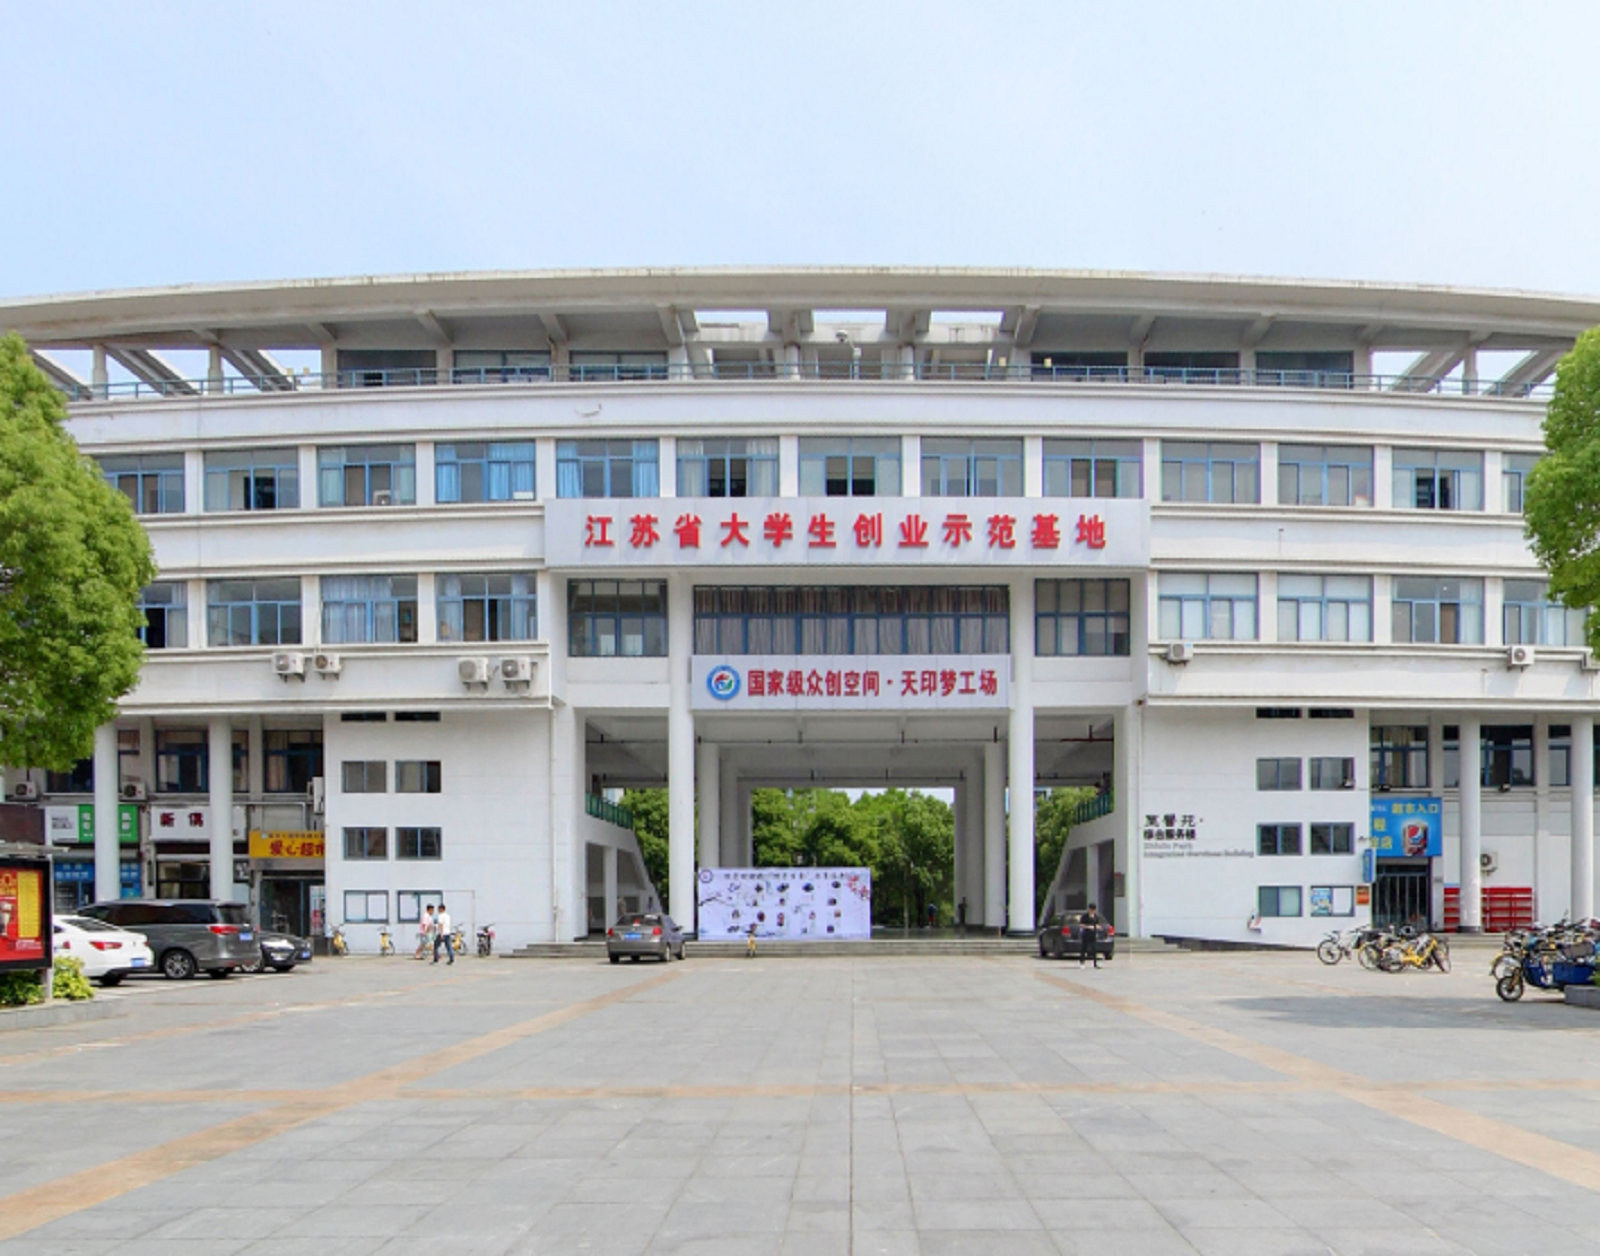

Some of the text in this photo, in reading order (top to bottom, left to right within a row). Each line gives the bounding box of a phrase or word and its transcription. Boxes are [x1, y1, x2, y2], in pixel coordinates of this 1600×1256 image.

[584, 511, 1108, 550] 江苏省大学生创业示范基地
